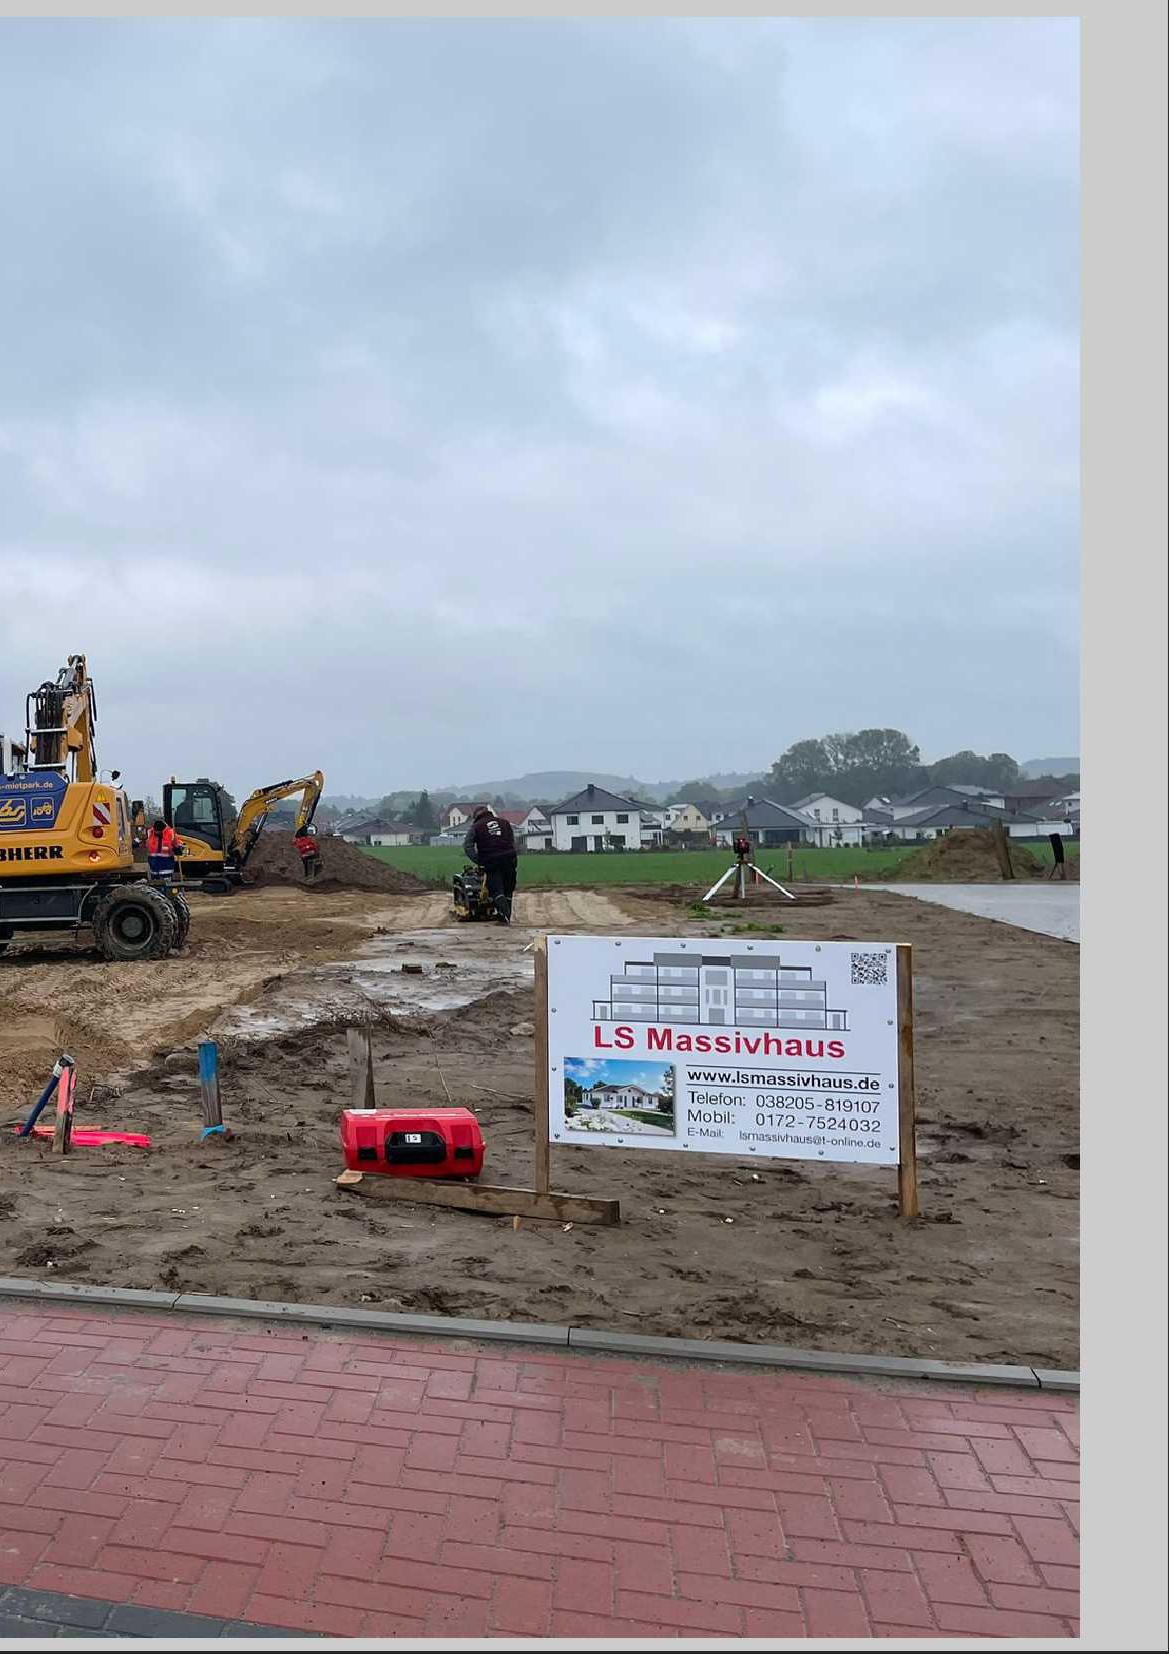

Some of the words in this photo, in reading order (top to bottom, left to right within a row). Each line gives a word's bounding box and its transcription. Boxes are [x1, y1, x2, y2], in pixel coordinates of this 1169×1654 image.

[594, 1025, 635, 1049] LS
[647, 1027, 846, 1058] Massivhaus
[687, 1070, 880, 1090] www.lsmassivhaus.de
[688, 1091, 746, 1106] Telefon:
[756, 1094, 880, 1113] 038205-819107
[688, 1109, 735, 1124] Mobil:
[756, 1113, 881, 1133] 0172-7524032
[688, 1128, 724, 1138] E-Mail:
[739, 1130, 881, 1149] lsmassivhaus@t-online.de
